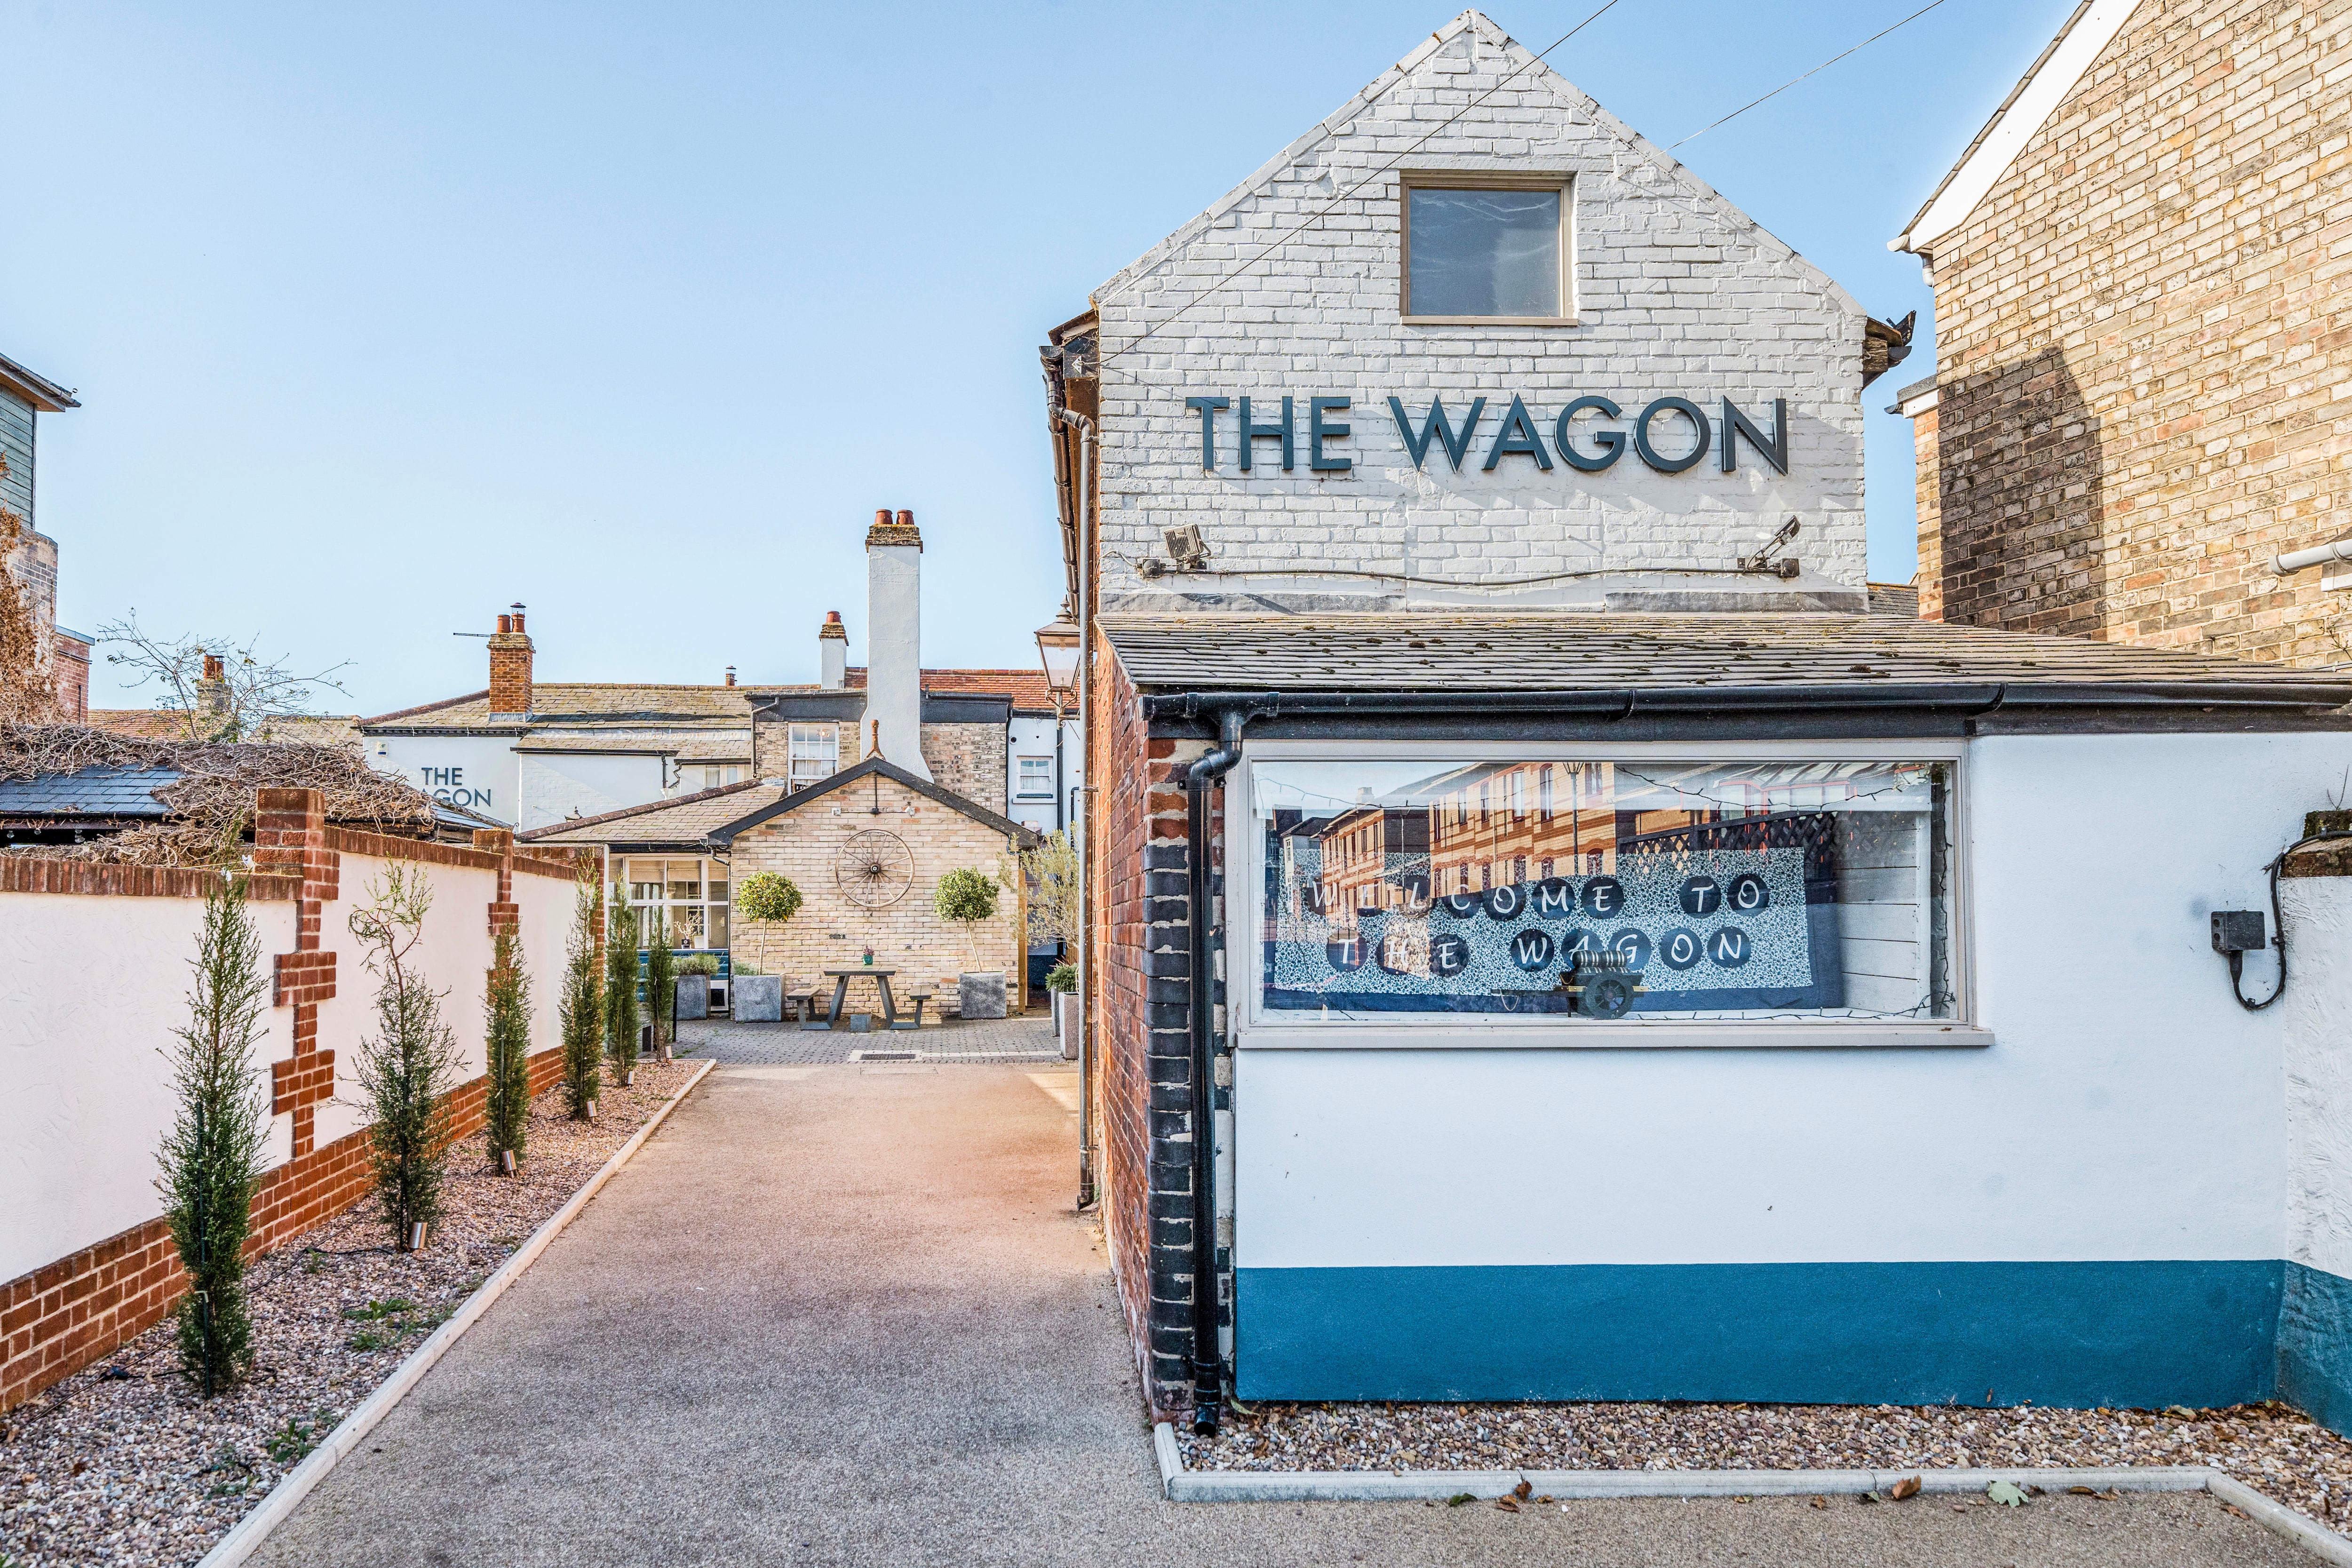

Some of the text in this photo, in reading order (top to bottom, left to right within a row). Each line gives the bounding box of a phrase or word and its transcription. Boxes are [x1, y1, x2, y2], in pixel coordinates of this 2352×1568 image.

[1185, 392, 1788, 477] THE WAGON
[421, 767, 463, 786] THE
[1312, 880, 1759, 914] WELCOME TO
[1337, 933, 1740, 969] THE WAGON
